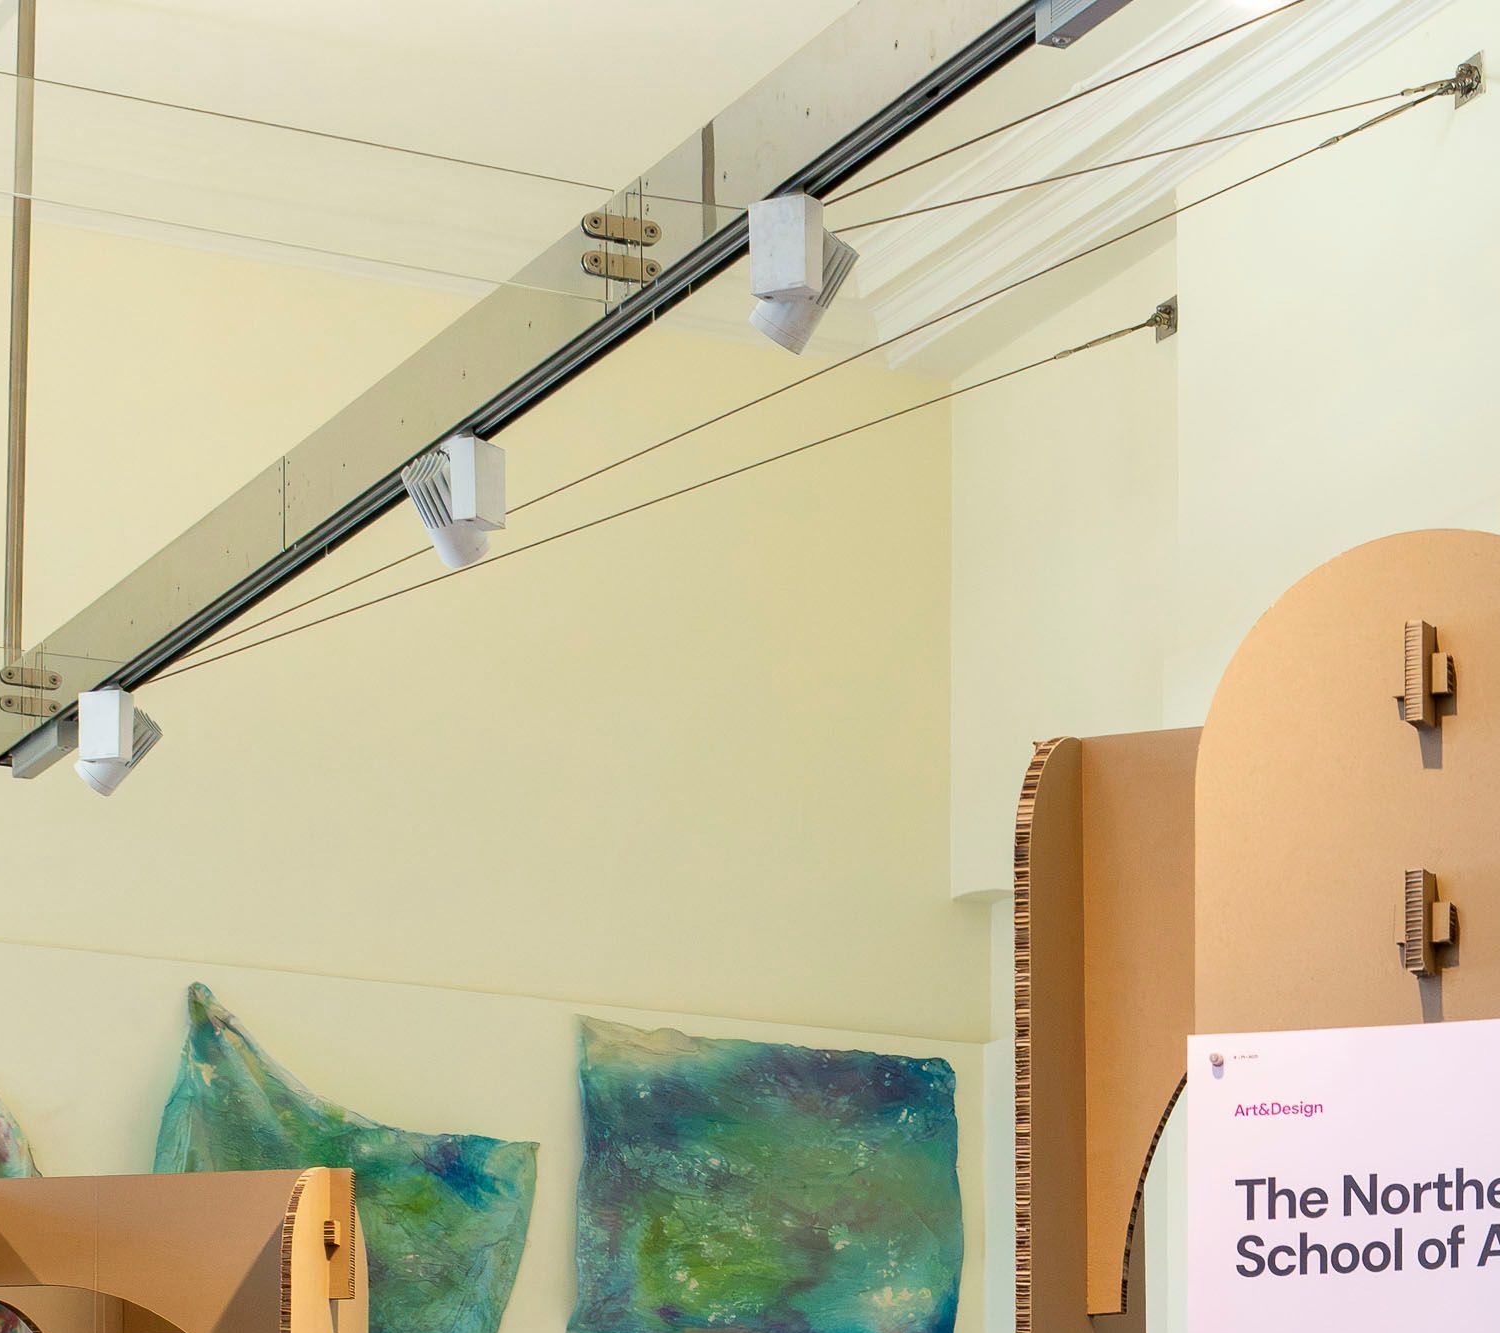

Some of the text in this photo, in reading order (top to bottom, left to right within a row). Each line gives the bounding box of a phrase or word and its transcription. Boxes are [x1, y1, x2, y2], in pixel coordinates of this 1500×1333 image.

[1234, 1101, 1323, 1118] Art&Design
[1235, 1177, 1329, 1221] The
[1236, 1227, 1403, 1278] School
[1417, 1224, 1465, 1270] of
